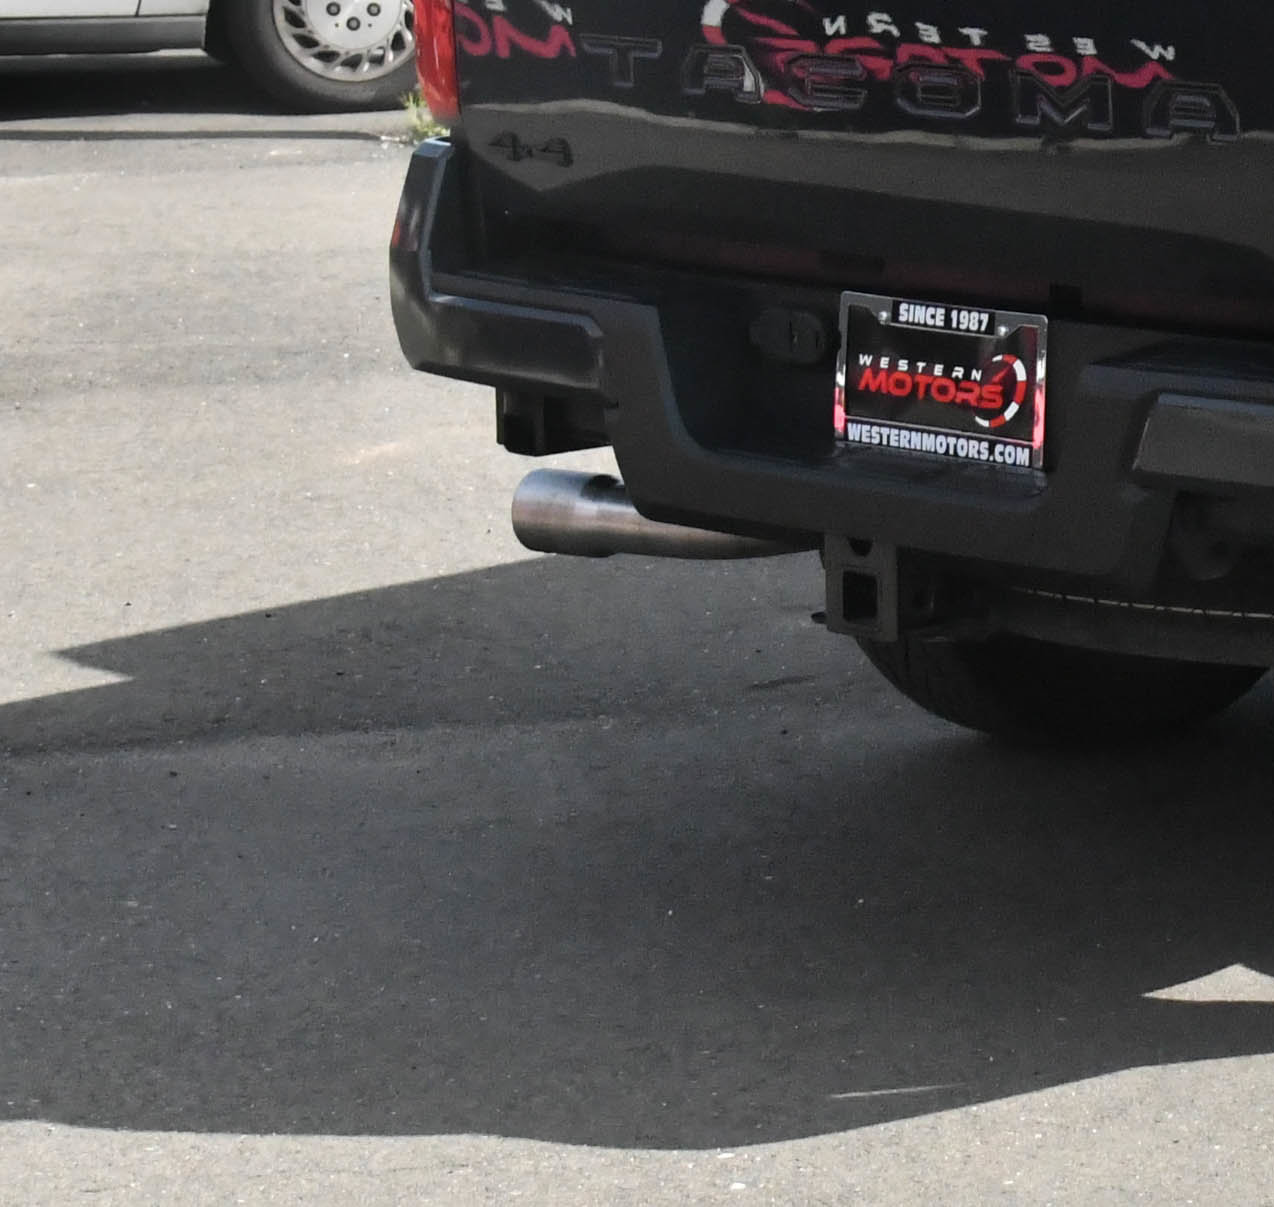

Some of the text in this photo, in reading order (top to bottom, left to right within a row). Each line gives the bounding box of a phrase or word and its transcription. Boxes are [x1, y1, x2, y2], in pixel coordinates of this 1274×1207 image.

[578, 32, 1242, 142] TACOMA
[898, 302, 990, 333] SINCE 1987
[857, 367, 1004, 410] MOTORS
[859, 353, 983, 382] WESTERN
[847, 422, 1031, 468] WESTERNMOTORS.COM
